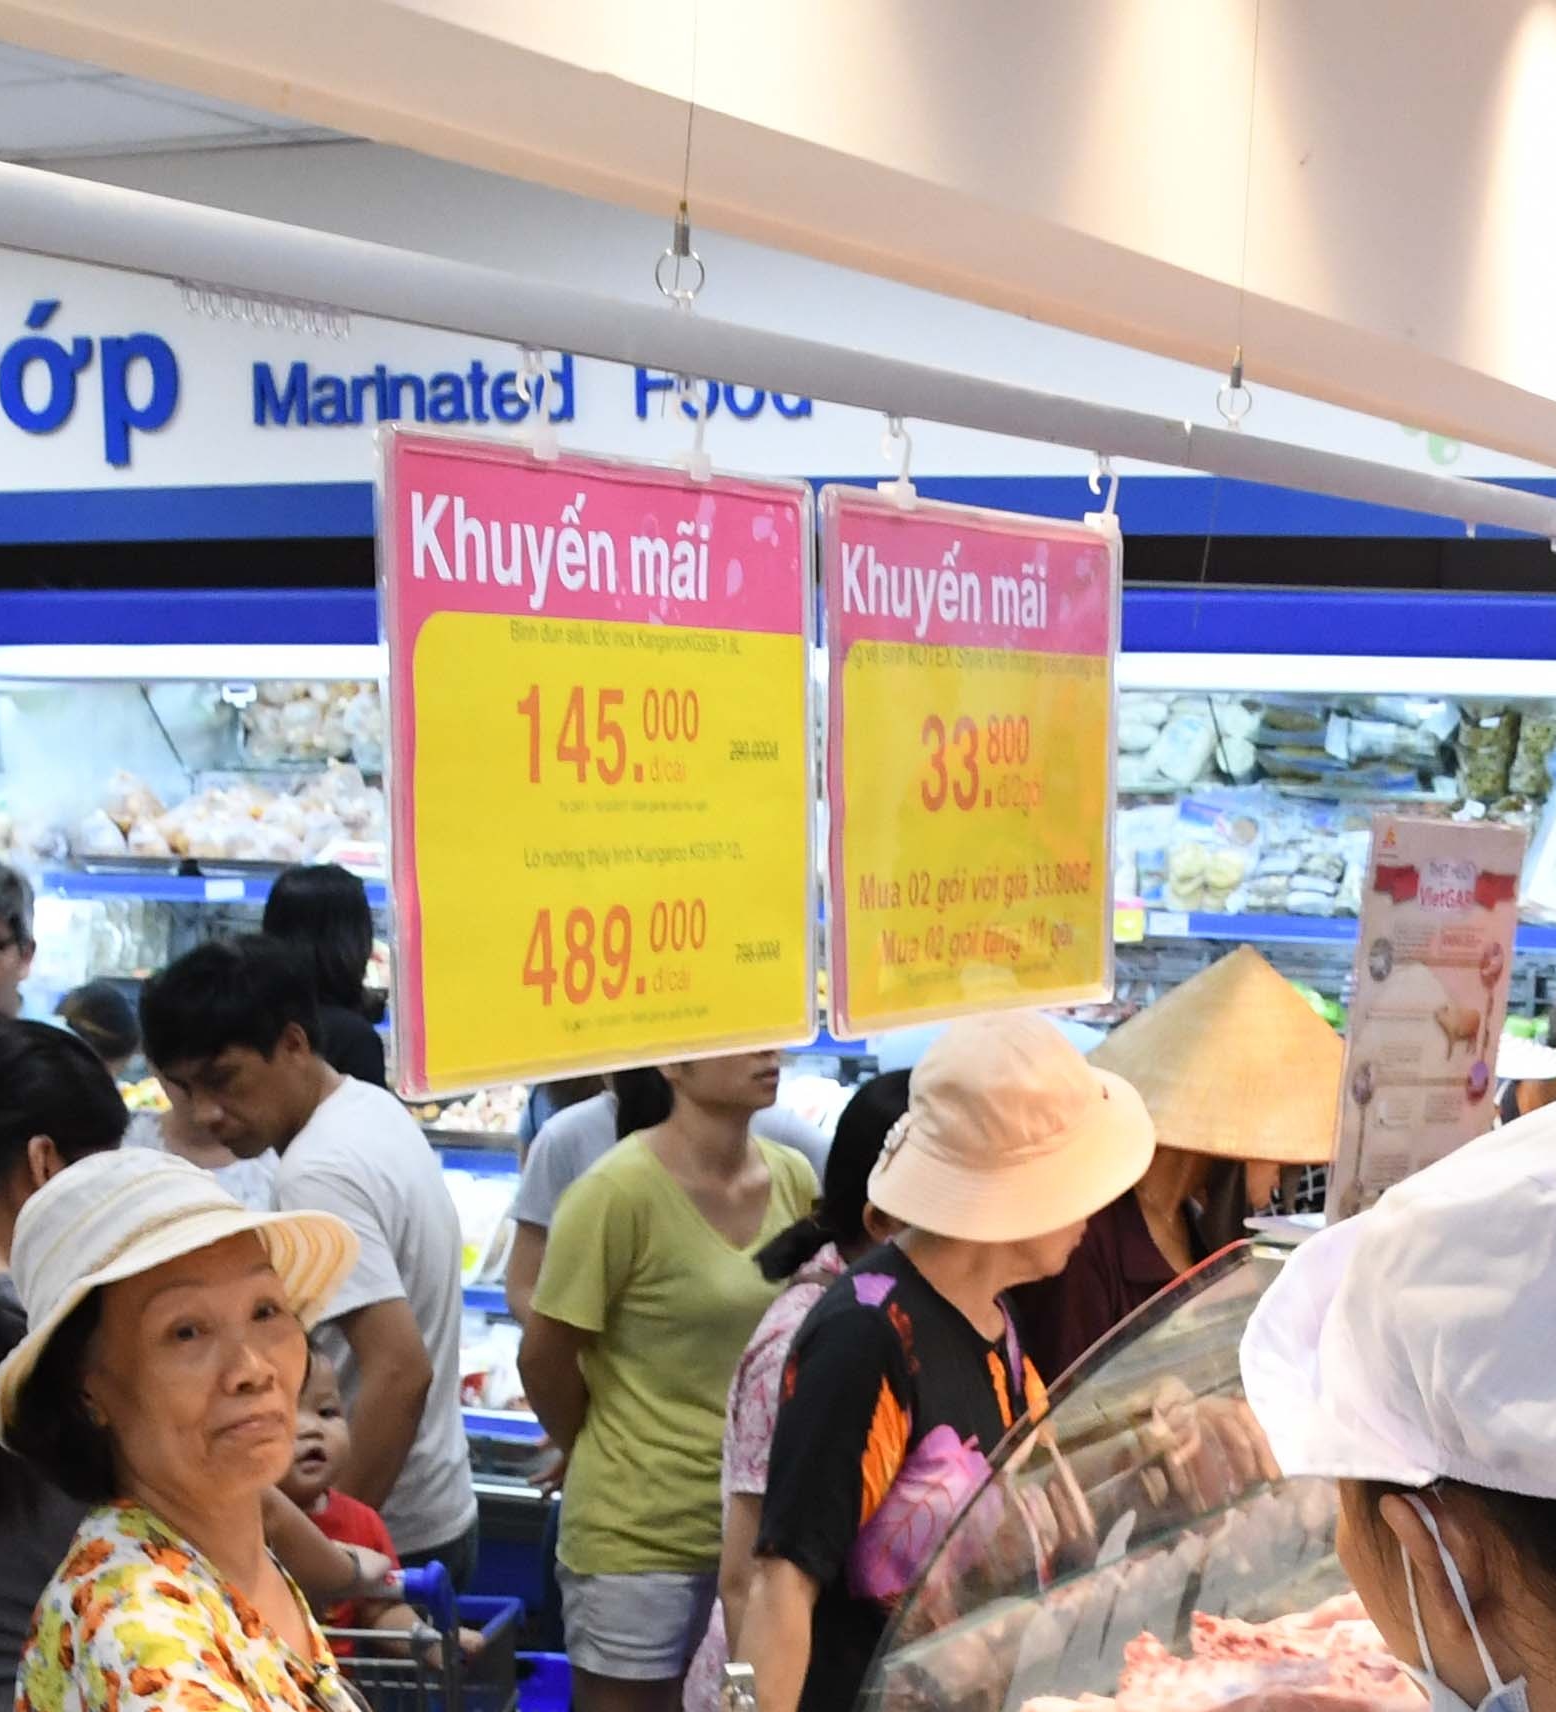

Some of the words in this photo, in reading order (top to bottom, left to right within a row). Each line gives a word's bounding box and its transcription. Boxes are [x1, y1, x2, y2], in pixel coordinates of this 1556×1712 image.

[252, 353, 575, 427] Marinated
[412, 492, 616, 610] Khuyến
[631, 520, 710, 601] mãi
[842, 540, 981, 638] Khuyến
[991, 562, 1047, 629] mãi
[859, 871, 902, 911] Mua
[908, 868, 931, 907] 02
